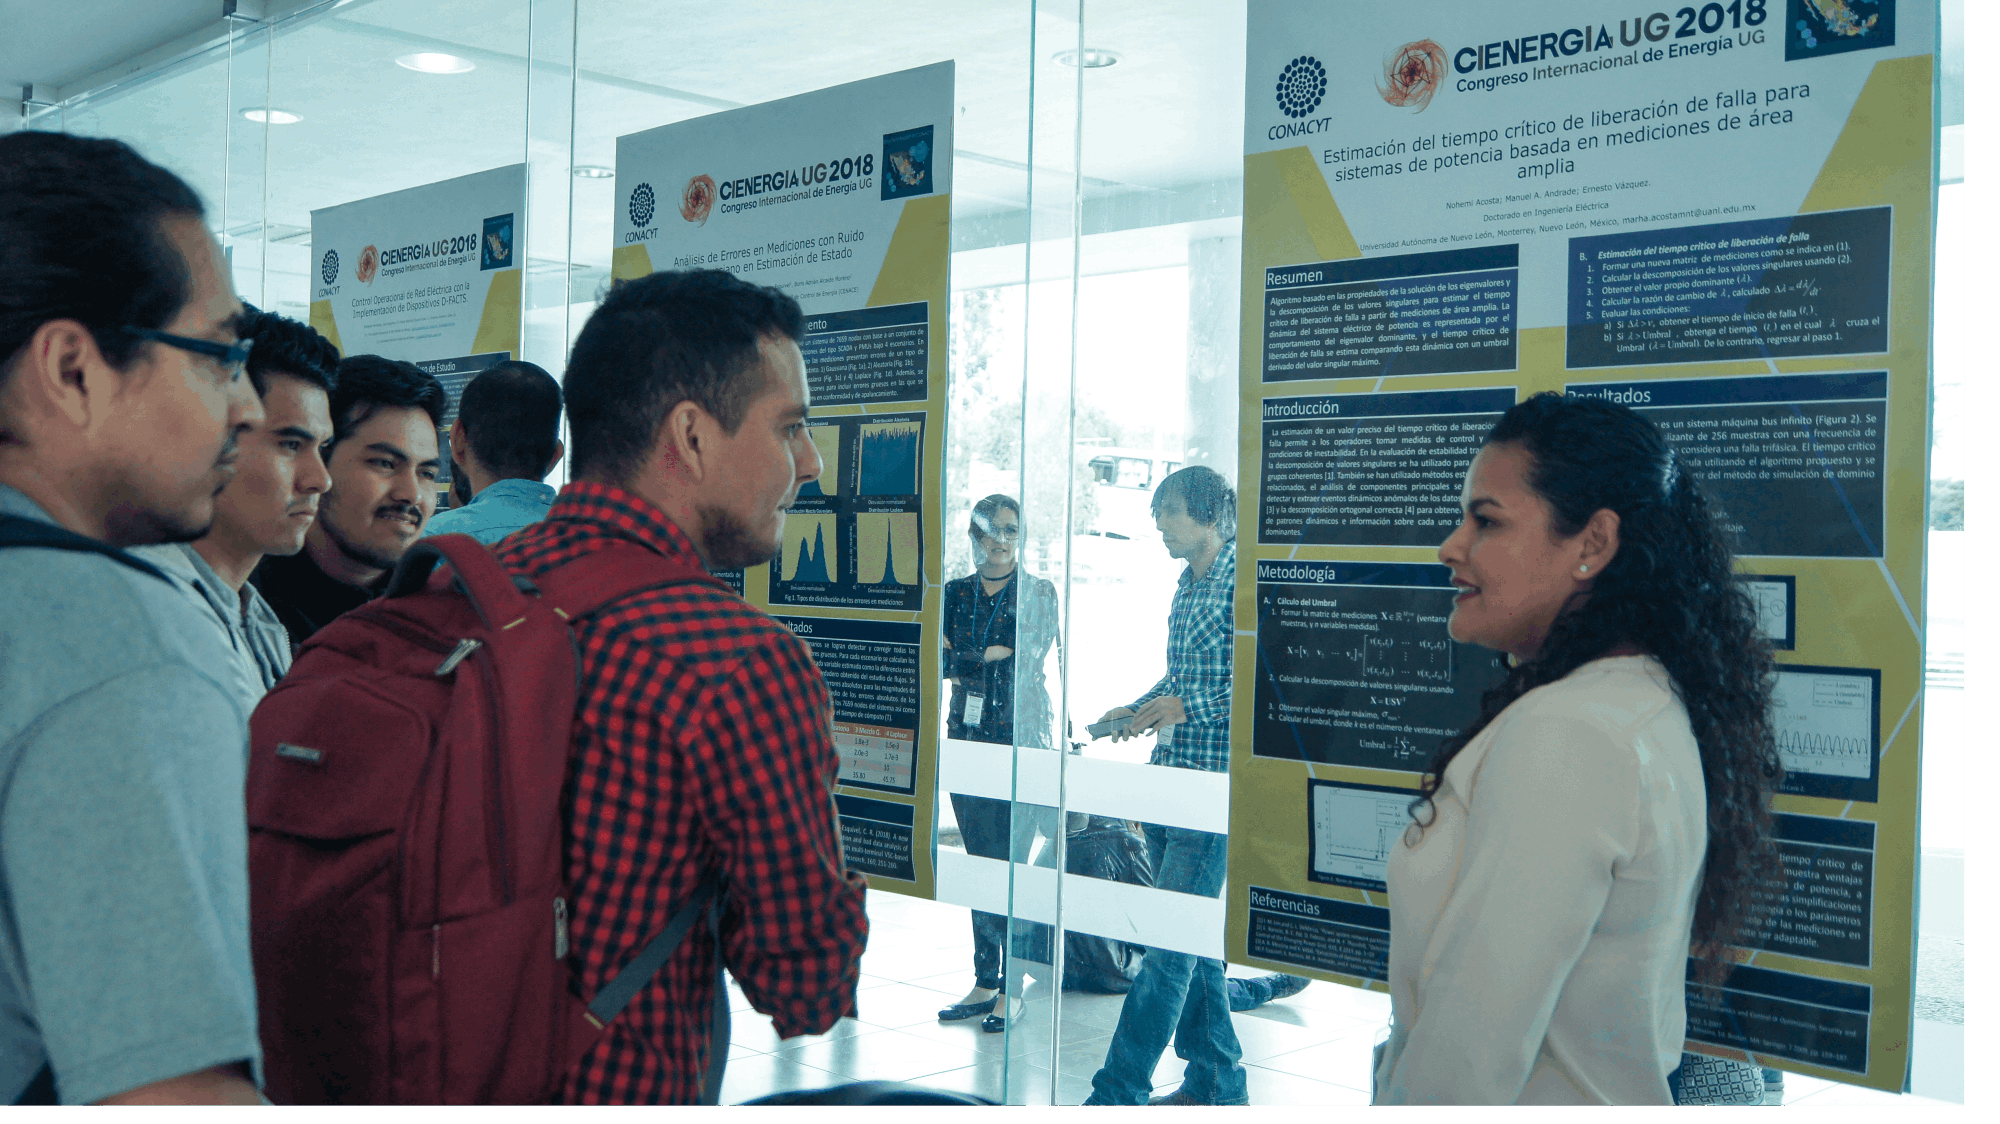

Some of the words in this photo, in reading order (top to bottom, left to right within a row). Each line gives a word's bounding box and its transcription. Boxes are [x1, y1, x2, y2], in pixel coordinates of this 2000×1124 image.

[1454, 24, 1614, 74] CIENERGIA
[1620, 12, 1670, 47] UG
[1675, 0, 1768, 39] 2018
[1456, 71, 1528, 92] Congreso
[1533, 51, 1638, 80] Internacional
[1643, 48, 1664, 62] de
[1669, 35, 1733, 58] Energía
[1738, 30, 1765, 46] UG
[1268, 117, 1332, 140] CONACYT
[1323, 138, 1406, 164] Estimación
[1412, 133, 1435, 152] del
[1441, 128, 1498, 148] tiempo
[1504, 119, 1556, 139] crítico
[1562, 113, 1584, 131] de
[1591, 99, 1678, 127] liberación
[1685, 95, 1708, 114] de
[1715, 88, 1757, 109] falla
[1765, 83, 1810, 107] para
[1335, 162, 1402, 182] sistemas
[1408, 156, 1428, 172] de
[1433, 146, 1503, 173] potencia
[1509, 136, 1570, 160] basada
[1577, 135, 1598, 150] en
[1606, 120, 1710, 147] mediciones
[1716, 113, 1741, 131] de
[1748, 109, 1793, 127] área
[720, 170, 799, 200] CIENERGIA
[802, 163, 827, 186] UG
[829, 153, 874, 182] 2018
[1517, 159, 1574, 180] amplia
[720, 200, 757, 214] Congreso
[759, 187, 811, 207] Internacional
[813, 187, 824, 197] de
[859, 178, 873, 190] UG
[1445, 199, 1473, 209] Nohemi
[1475, 197, 1502, 206] Acosta;
[1505, 192, 1532, 202] Manuel
[1543, 187, 1579, 198] Andrade;
[1582, 183, 1613, 194] Ernesto
[1614, 179, 1651, 190] Vázquez.
[1483, 210, 1521, 222] Doctorado
[1522, 210, 1532, 218] en
[1534, 204, 1573, 217] Ingeniería
[1575, 201, 1609, 212] Eléctrica
[625, 228, 659, 243] CONACYT
[1358, 239, 1399, 251] Universidad
[1400, 237, 1437, 247] Autónoma
[1438, 235, 1449, 243] de
[1450, 233, 1473, 242] Nuevo
[1474, 230, 1495, 240] León,
[1497, 227, 1536, 237] Monterrey,
[1538, 223, 1564, 233] Nuevo
[1565, 220, 1587, 230] León,
[1589, 218, 1619, 227] México,
[1621, 204, 1756, 224] marha.acostamnt@uanl.edu.mx
[380, 244, 431, 266] CIENERGIA
[432, 239, 449, 257] UG
[450, 233, 477, 254] 2018
[672, 253, 705, 268] Análisis
[707, 251, 718, 263] de
[720, 247, 751, 261] Errores
[753, 246, 764, 256] en
[766, 238, 815, 254] Mediciones
[817, 235, 835, 247] con
[837, 228, 865, 244] Ruido
[742, 262, 754, 273] en
[756, 254, 804, 271] Estimación
[806, 251, 818, 264] de
[820, 246, 853, 262] Estado
[1597, 247, 1642, 260] Estimación
[1642, 245, 1657, 256] del
[1658, 244, 1689, 254] tiempo
[1689, 240, 1716, 251] crítico
[1717, 239, 1729, 249] de
[1730, 235, 1774, 247] liberación
[1775, 233, 1788, 244] de
[1787, 231, 1810, 244] falla
[1602, 262, 1630, 271] Formar
[1630, 260, 1646, 269] una
[1647, 258, 1671, 267] nueva
[1672, 255, 1697, 265] matriz
[1700, 253, 1712, 263] de
[1712, 251, 1759, 261] mediciones
[1760, 248, 1784, 258] como
[1785, 247, 1795, 255] se
[1796, 245, 1822, 254] indica
[1822, 244, 1835, 252] en
[1835, 242, 1851, 252] (1).
[381, 267, 405, 277] Congreso
[439, 258, 447, 266] de
[468, 253, 476, 262] UG
[1267, 269, 1323, 286] Resumen
[1264, 400, 1340, 417] Introducción
[1568, 387, 1651, 404] ltados
[1660, 421, 1670, 429] es
[1672, 420, 1684, 429] un
[1686, 419, 1719, 428] sistema
[1721, 417, 1759, 428] máquina
[1761, 416, 1778, 426] bus
[1780, 414, 1812, 425] infinito
[1814, 414, 1847, 426] (Figura
[1865, 413, 1877, 423] Se
[1258, 565, 1335, 582] Metodología
[1251, 891, 1321, 915] Referencias
